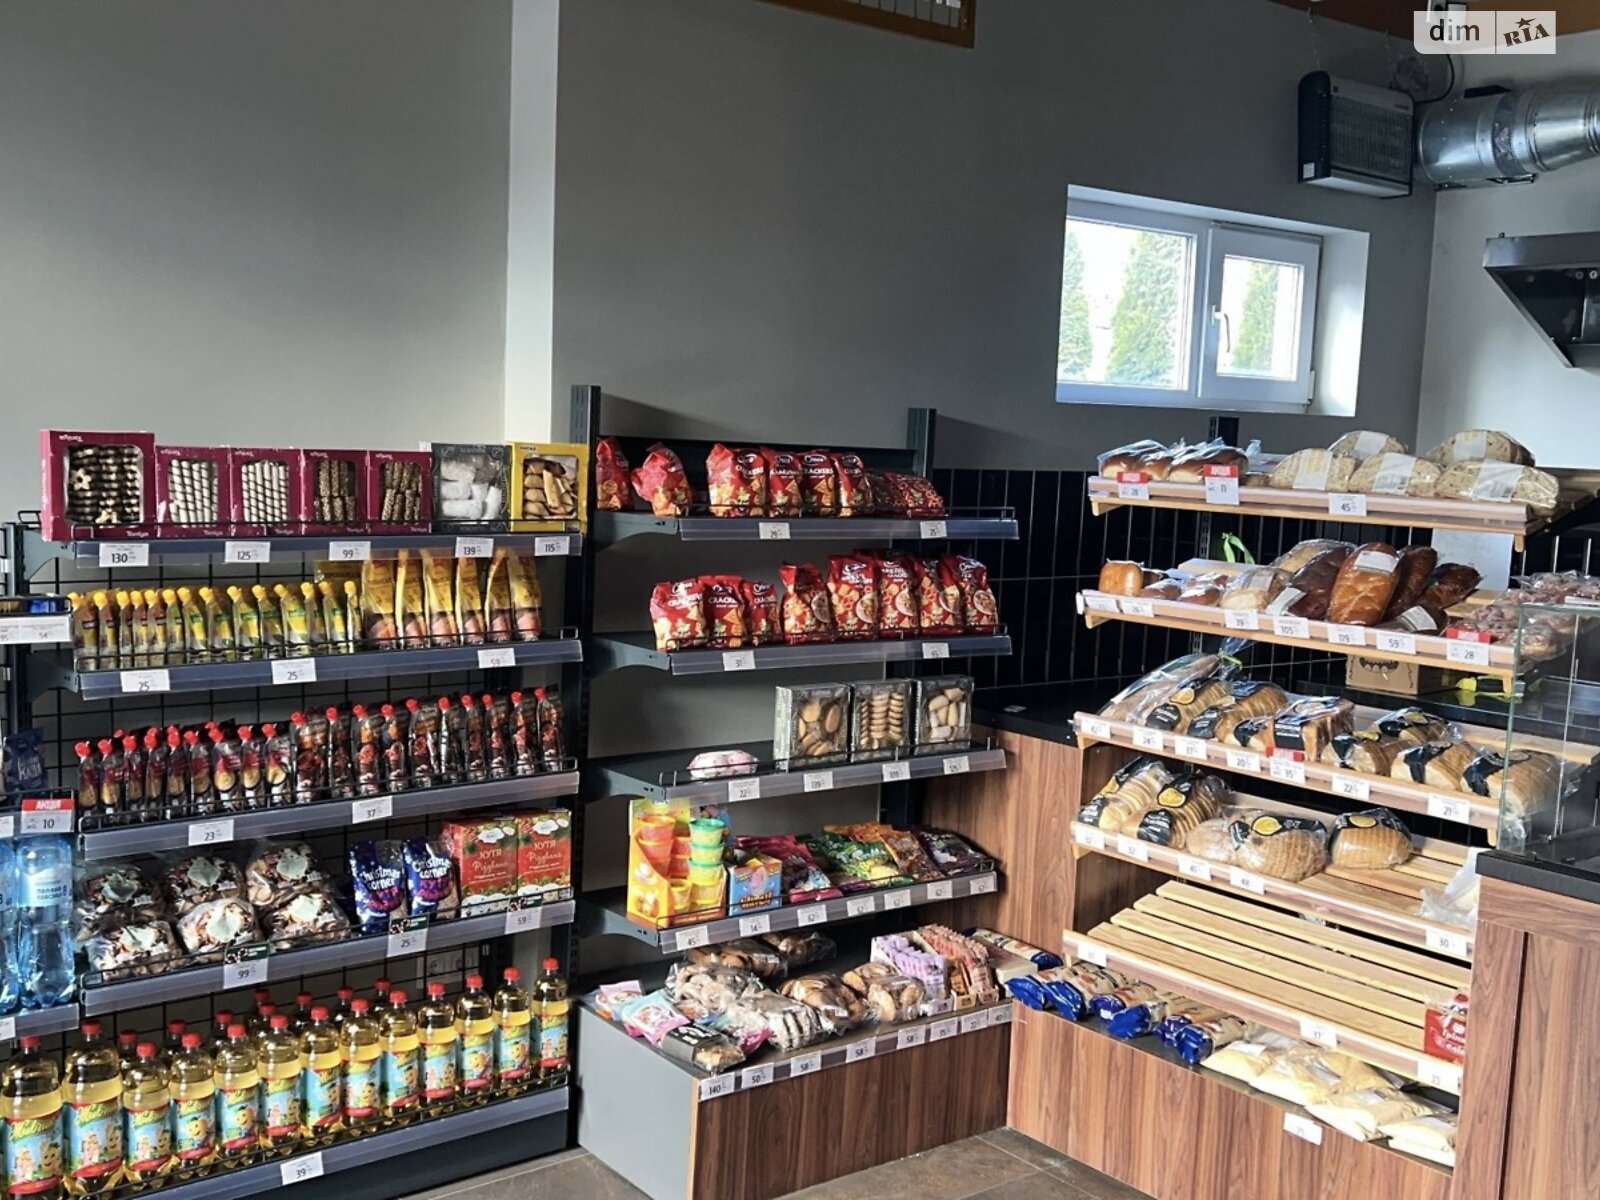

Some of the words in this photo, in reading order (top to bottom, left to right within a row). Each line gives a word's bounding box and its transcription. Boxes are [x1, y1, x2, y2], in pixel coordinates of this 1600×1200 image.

[1341, 503, 1351, 512] 45
[342, 549, 354, 559] 99
[463, 546, 476, 555] 139
[111, 552, 129, 563] 130
[237, 551, 251, 560] 125
[1389, 639, 1399, 648] 59
[1464, 650, 1475, 659] 28
[287, 672, 298, 680] 25
[138, 681, 150, 691] 25
[367, 809, 376, 818] 37
[43, 819, 55, 829] 10
[204, 832, 215, 841] 23
[401, 938, 411, 948] 25
[238, 969, 249, 979] 99
[751, 1075, 761, 1084] 50
[709, 1086, 721, 1095] 140
